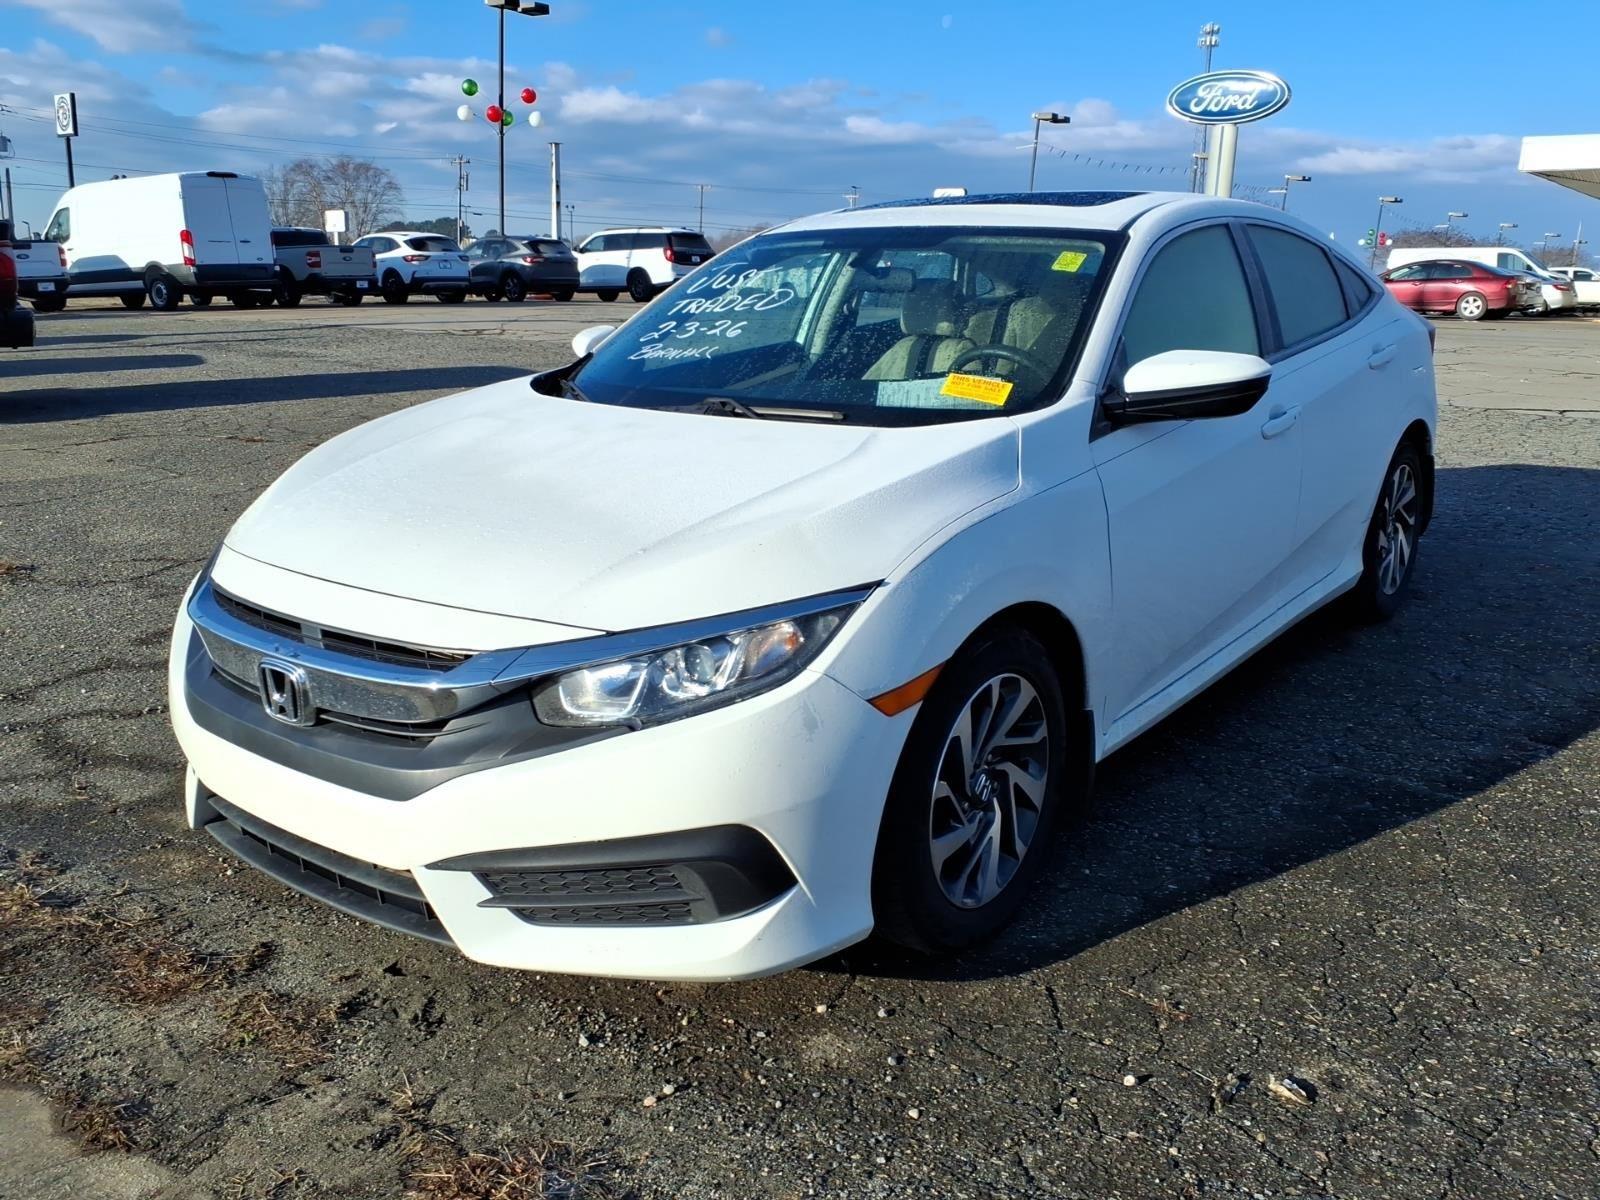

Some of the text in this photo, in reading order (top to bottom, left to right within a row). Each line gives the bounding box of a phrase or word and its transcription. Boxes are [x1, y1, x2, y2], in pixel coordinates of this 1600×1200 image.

[1190, 81, 1258, 112] Ford
[686, 262, 783, 293] JUST
[667, 289, 794, 315] TRADED
[639, 320, 747, 341] 2-3-26
